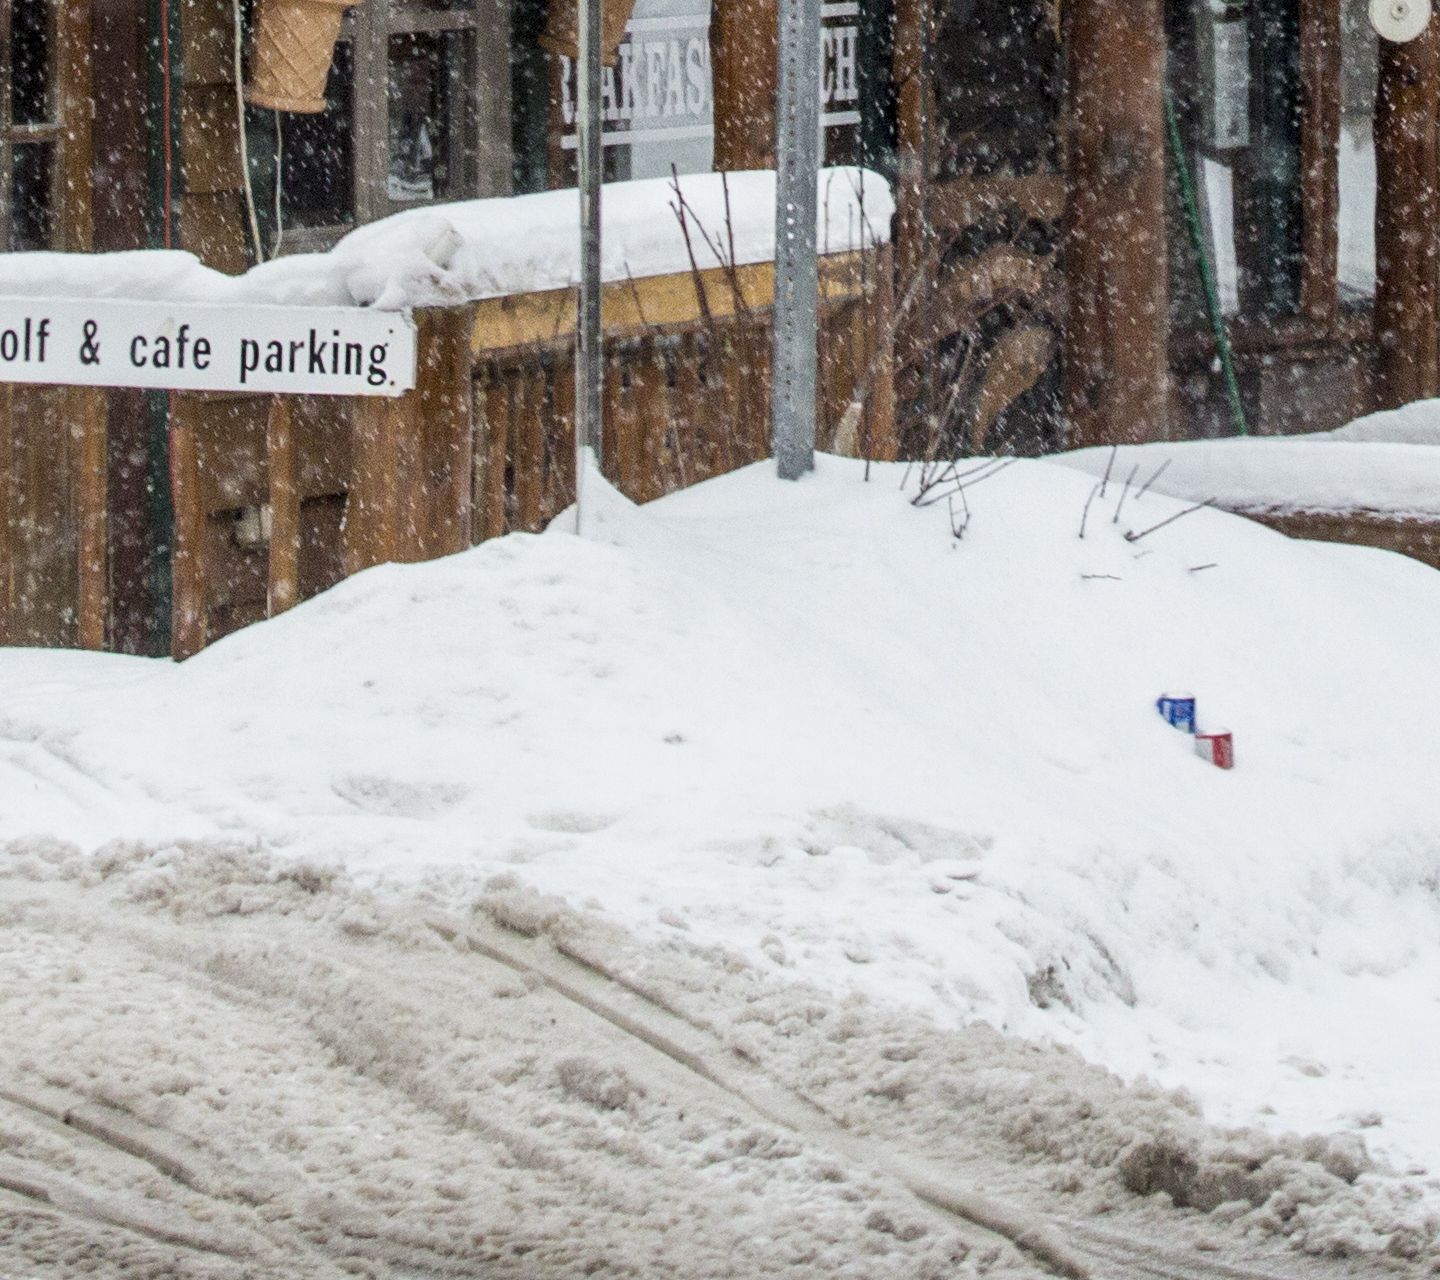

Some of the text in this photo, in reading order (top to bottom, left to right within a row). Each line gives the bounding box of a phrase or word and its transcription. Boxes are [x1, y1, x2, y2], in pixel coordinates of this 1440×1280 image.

[79, 319, 102, 367] &
[129, 323, 212, 372] cafe
[239, 328, 389, 386] parking
